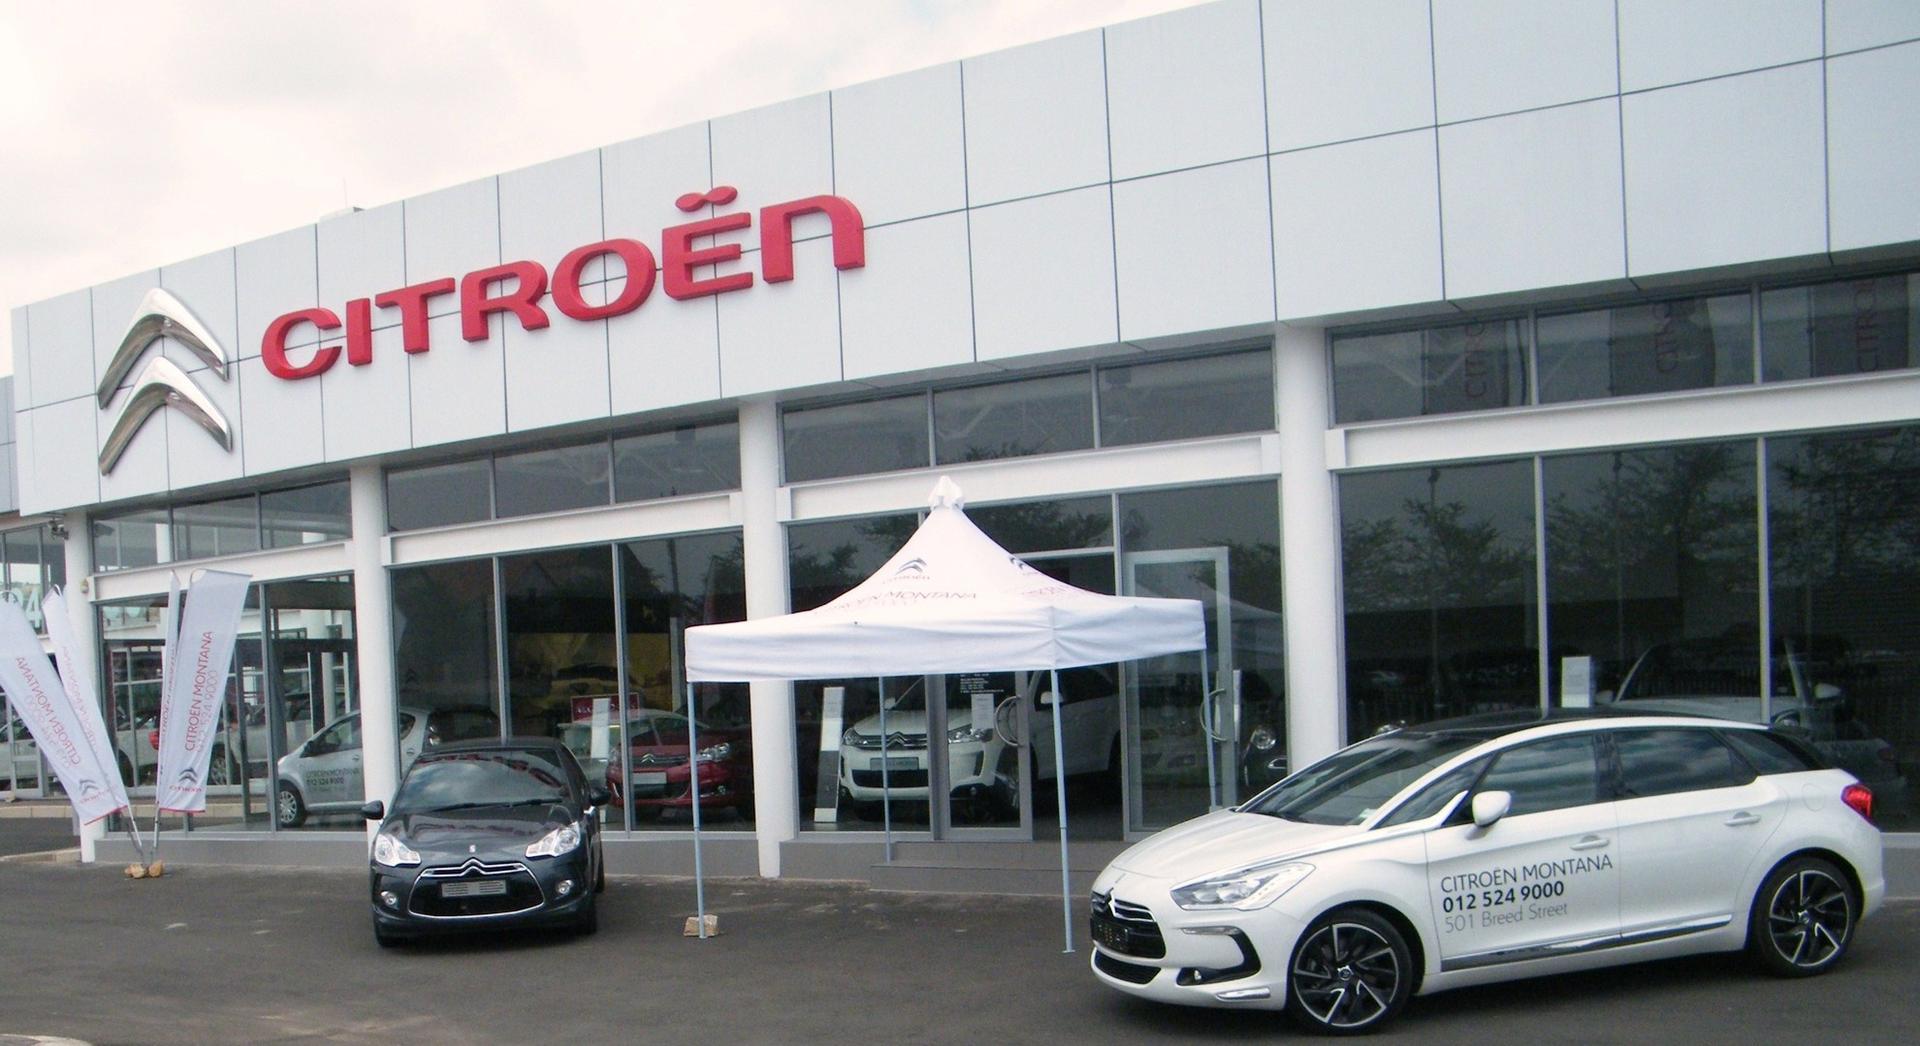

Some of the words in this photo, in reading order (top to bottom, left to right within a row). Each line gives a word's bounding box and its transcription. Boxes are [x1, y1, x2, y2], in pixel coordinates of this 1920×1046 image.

[193, 631, 214, 697] MONTANA
[1522, 854, 1614, 881] MONTANA
[1442, 896, 1477, 914] 012
[1482, 889, 1516, 908] 524
[1520, 880, 1565, 901] 9000
[1445, 914, 1475, 934] 501
[1481, 907, 1524, 928] Breed
[1528, 902, 1569, 920] Street
